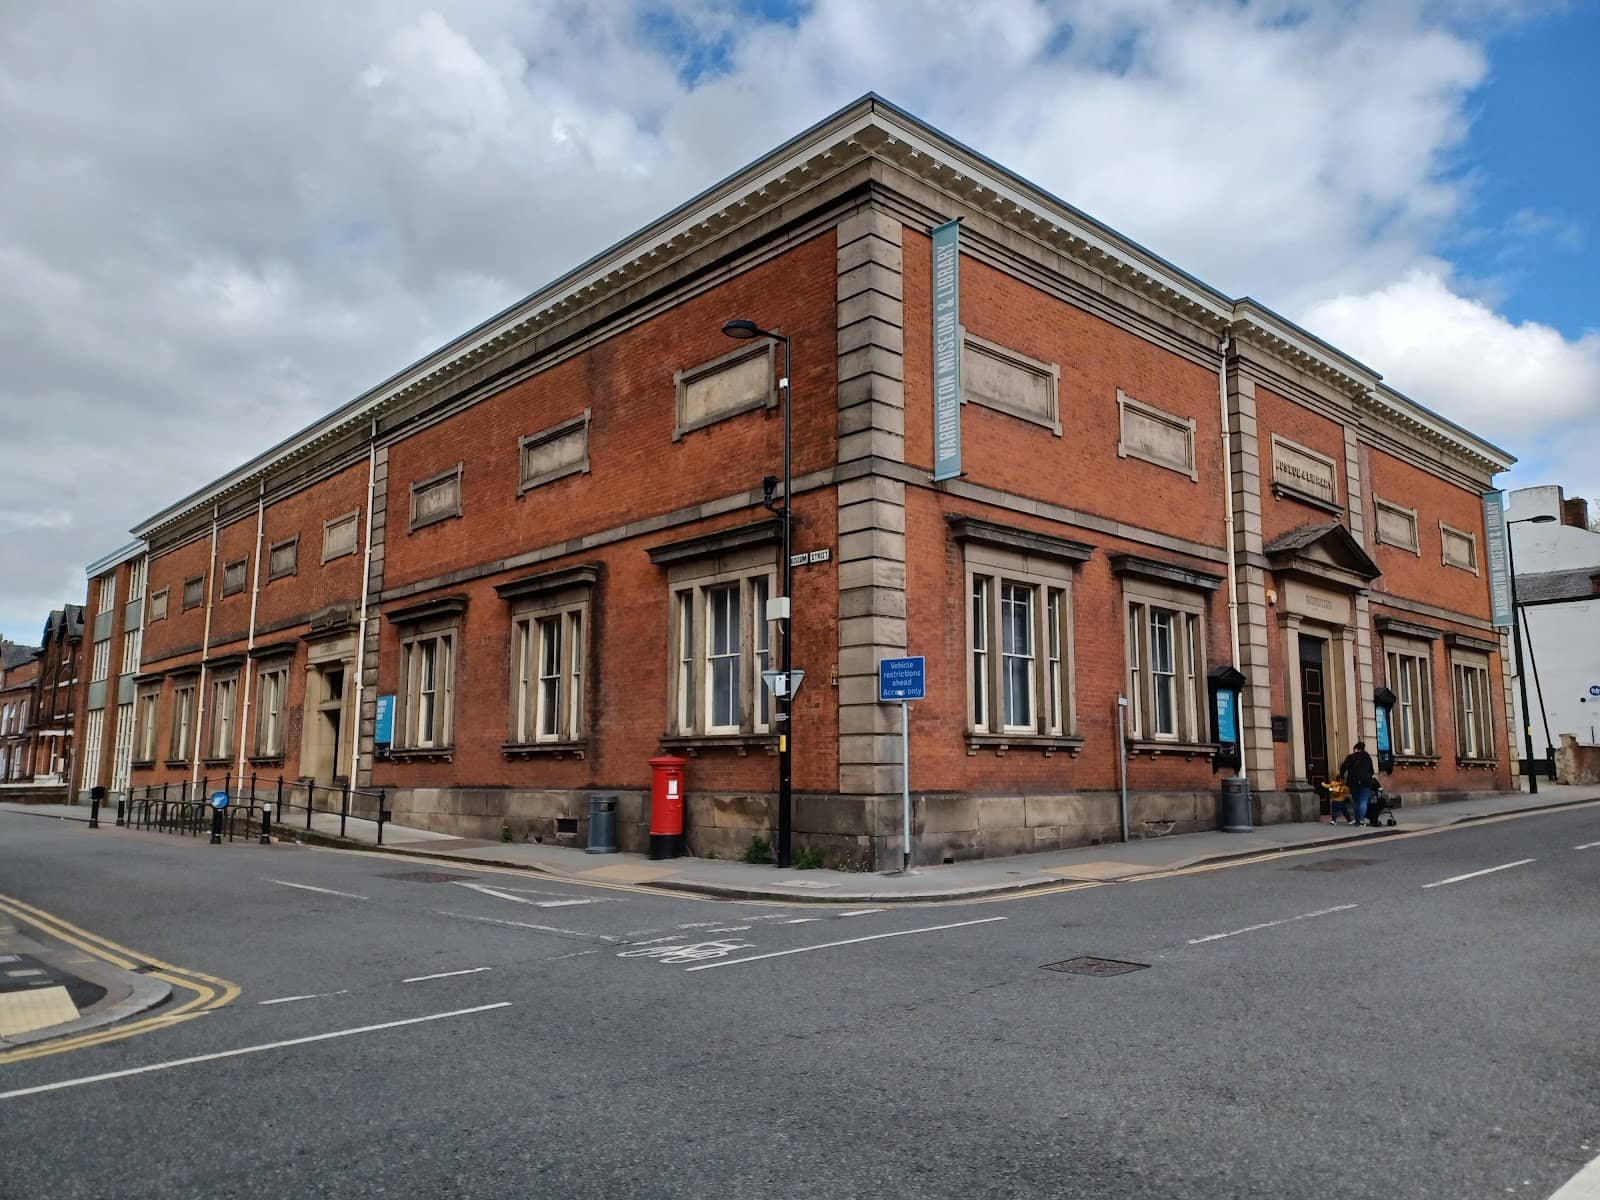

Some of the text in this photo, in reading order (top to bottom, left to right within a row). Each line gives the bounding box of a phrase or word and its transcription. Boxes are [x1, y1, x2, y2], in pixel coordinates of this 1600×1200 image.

[937, 243, 956, 461] WARRINGTON MUSEUM & LIBRARY
[1487, 502, 1502, 530] LIBRARY
[1490, 540, 1505, 571] MUSEUM
[1493, 572, 1509, 617] WARRINGTON
[884, 670, 921, 678] restrictions
[892, 679, 913, 687] ahead
[907, 688, 922, 696] only
